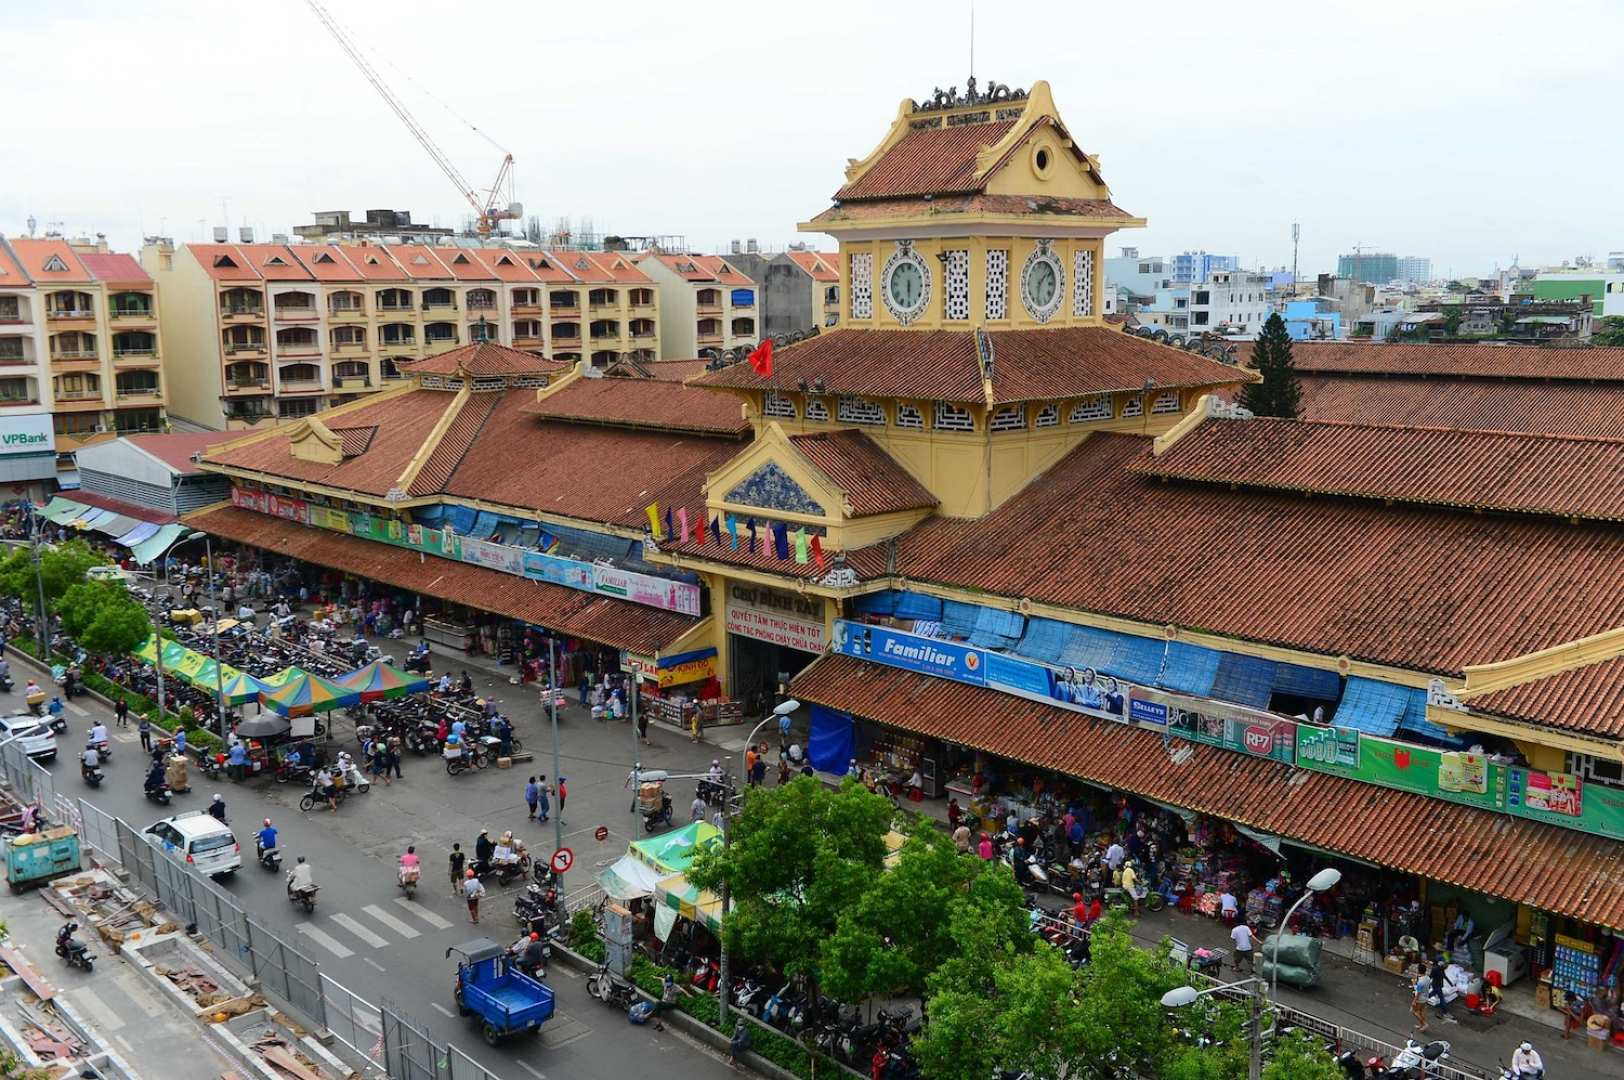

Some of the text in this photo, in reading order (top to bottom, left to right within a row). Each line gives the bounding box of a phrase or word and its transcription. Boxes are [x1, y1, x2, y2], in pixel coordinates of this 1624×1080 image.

[2, 432, 48, 444] VPBank
[884, 638, 955, 666] Familiar
[1133, 701, 1164, 715] SELLEYS
[1246, 732, 1269, 748] RP7
